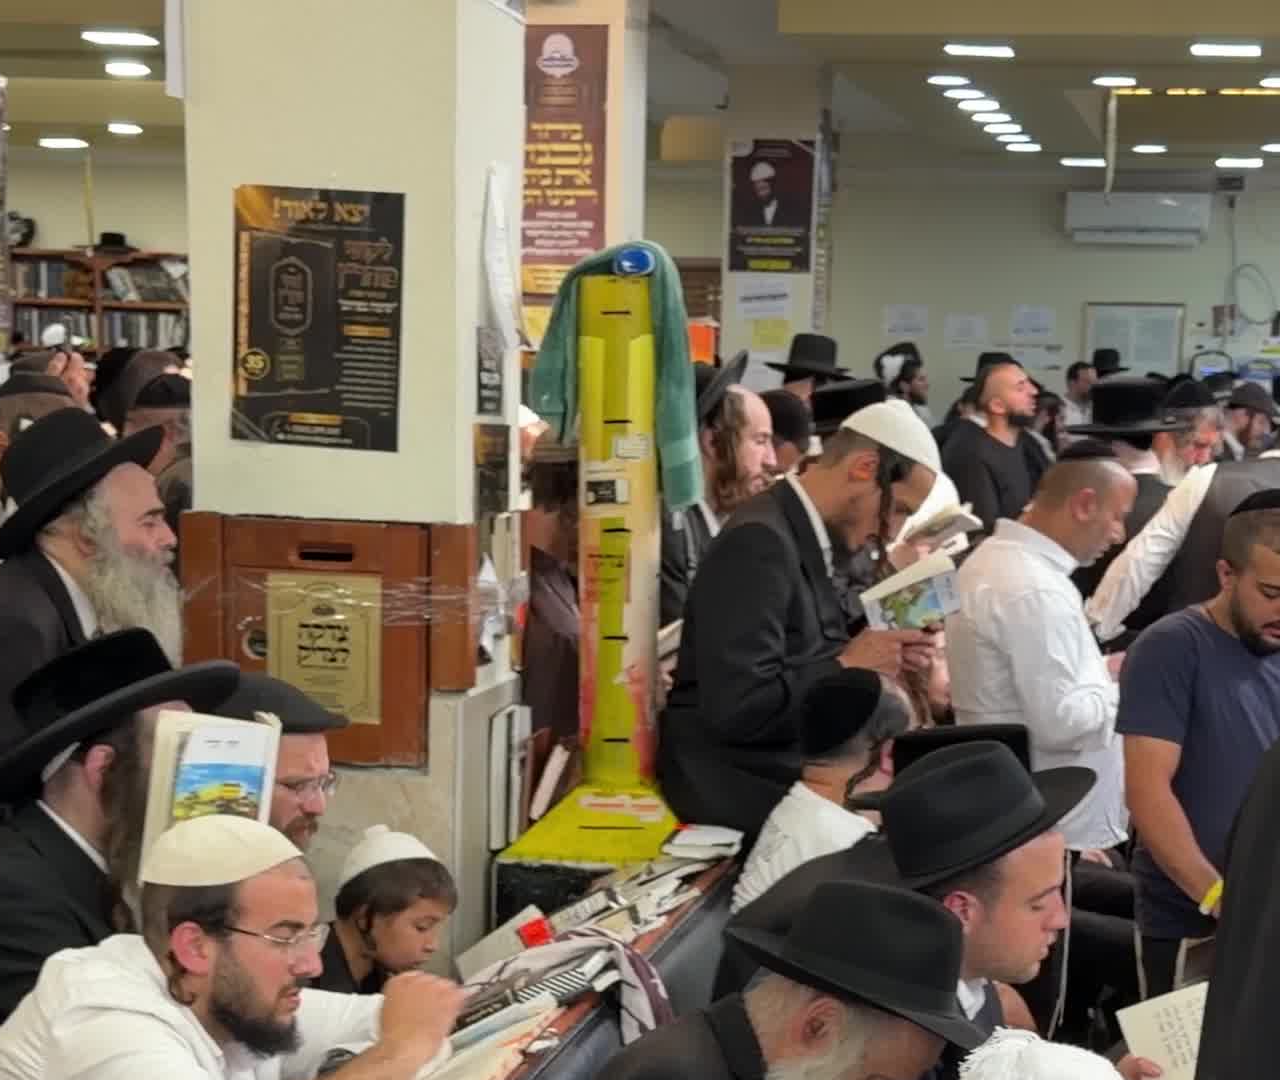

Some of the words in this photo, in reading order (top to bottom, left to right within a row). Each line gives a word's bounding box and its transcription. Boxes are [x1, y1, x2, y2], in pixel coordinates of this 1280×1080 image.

[272, 193, 329, 224] לאור!
[333, 201, 370, 223] יצא
[245, 354, 265, 369] 35
